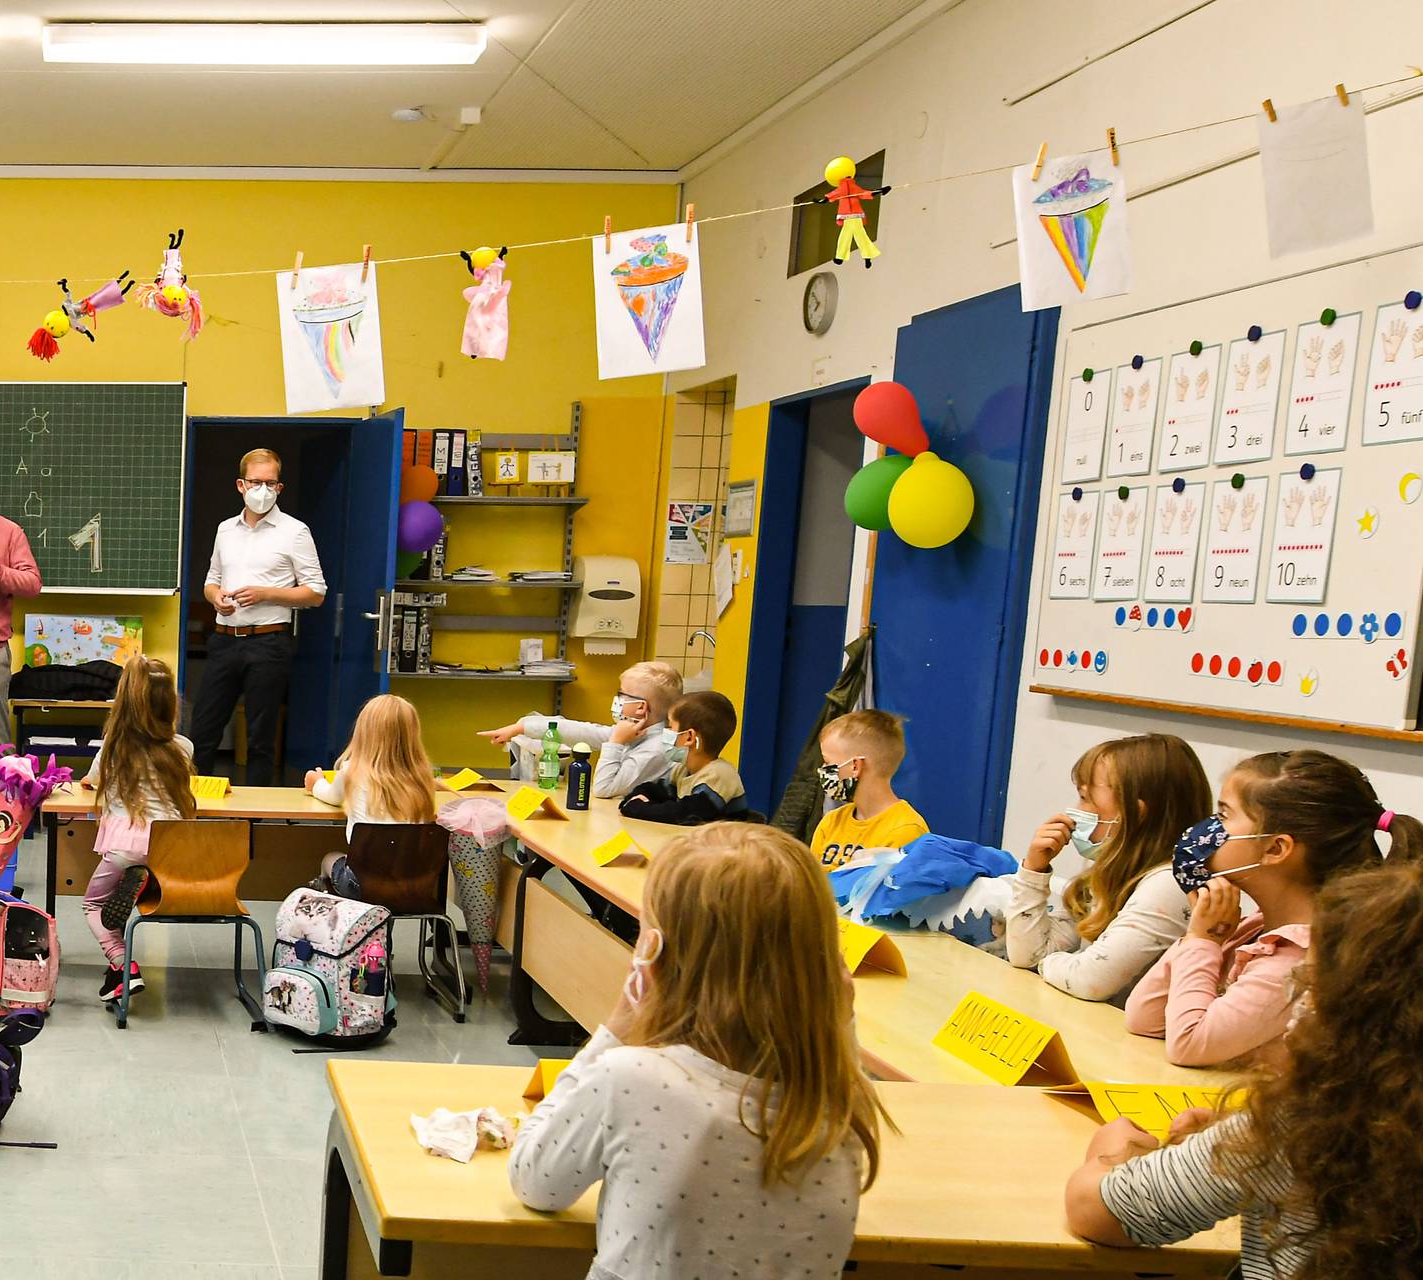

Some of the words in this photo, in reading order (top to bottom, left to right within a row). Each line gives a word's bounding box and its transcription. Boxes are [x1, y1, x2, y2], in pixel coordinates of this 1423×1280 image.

[1084, 391, 1093, 412] 0
[1378, 401, 1391, 427] 5
[1227, 425, 1238, 449] 3
[1245, 433, 1263, 446] drei
[1297, 414, 1310, 438] 4
[1318, 422, 1336, 436] vier
[1118, 442, 1124, 463] 1
[1169, 434, 1179, 456] 2
[1184, 441, 1203, 455] zwei
[15, 456, 28, 475] A
[40, 467, 52, 477] a
[37, 528, 47, 548] 1
[1059, 566, 1067, 586] 6
[1104, 566, 1112, 587] 7
[1155, 565, 1166, 588] 8
[1214, 565, 1225, 588] 9
[1228, 579, 1249, 588] neun
[1277, 562, 1296, 586] 10
[1296, 573, 1317, 586] zehn
[578, 772, 587, 801] EVOLUTION
[944, 999, 1046, 1073] ANNABELLA
